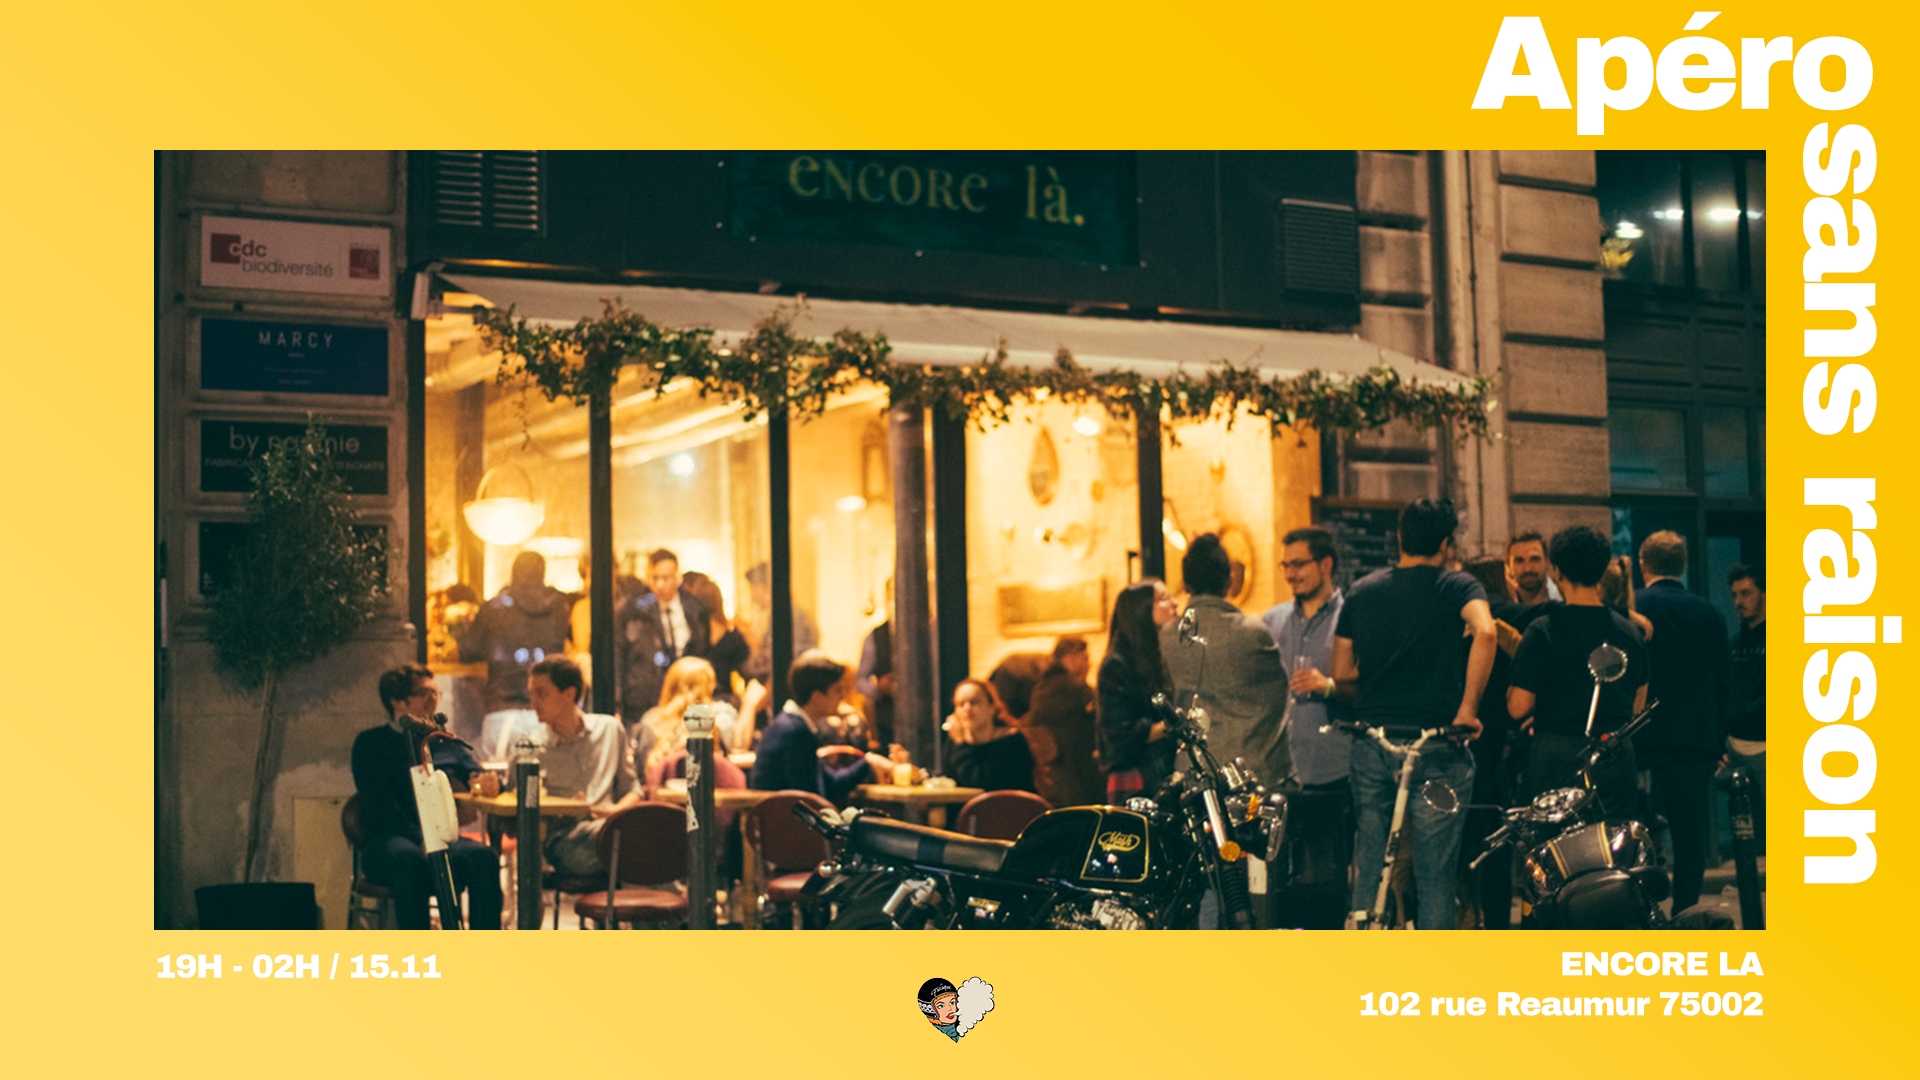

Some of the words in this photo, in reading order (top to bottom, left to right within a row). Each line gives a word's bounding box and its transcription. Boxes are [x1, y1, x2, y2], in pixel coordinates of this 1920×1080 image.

[229, 240, 267, 258] cdc
[242, 259, 333, 278] biodiversité
[258, 330, 333, 348] MARCY
[230, 425, 260, 457] by
